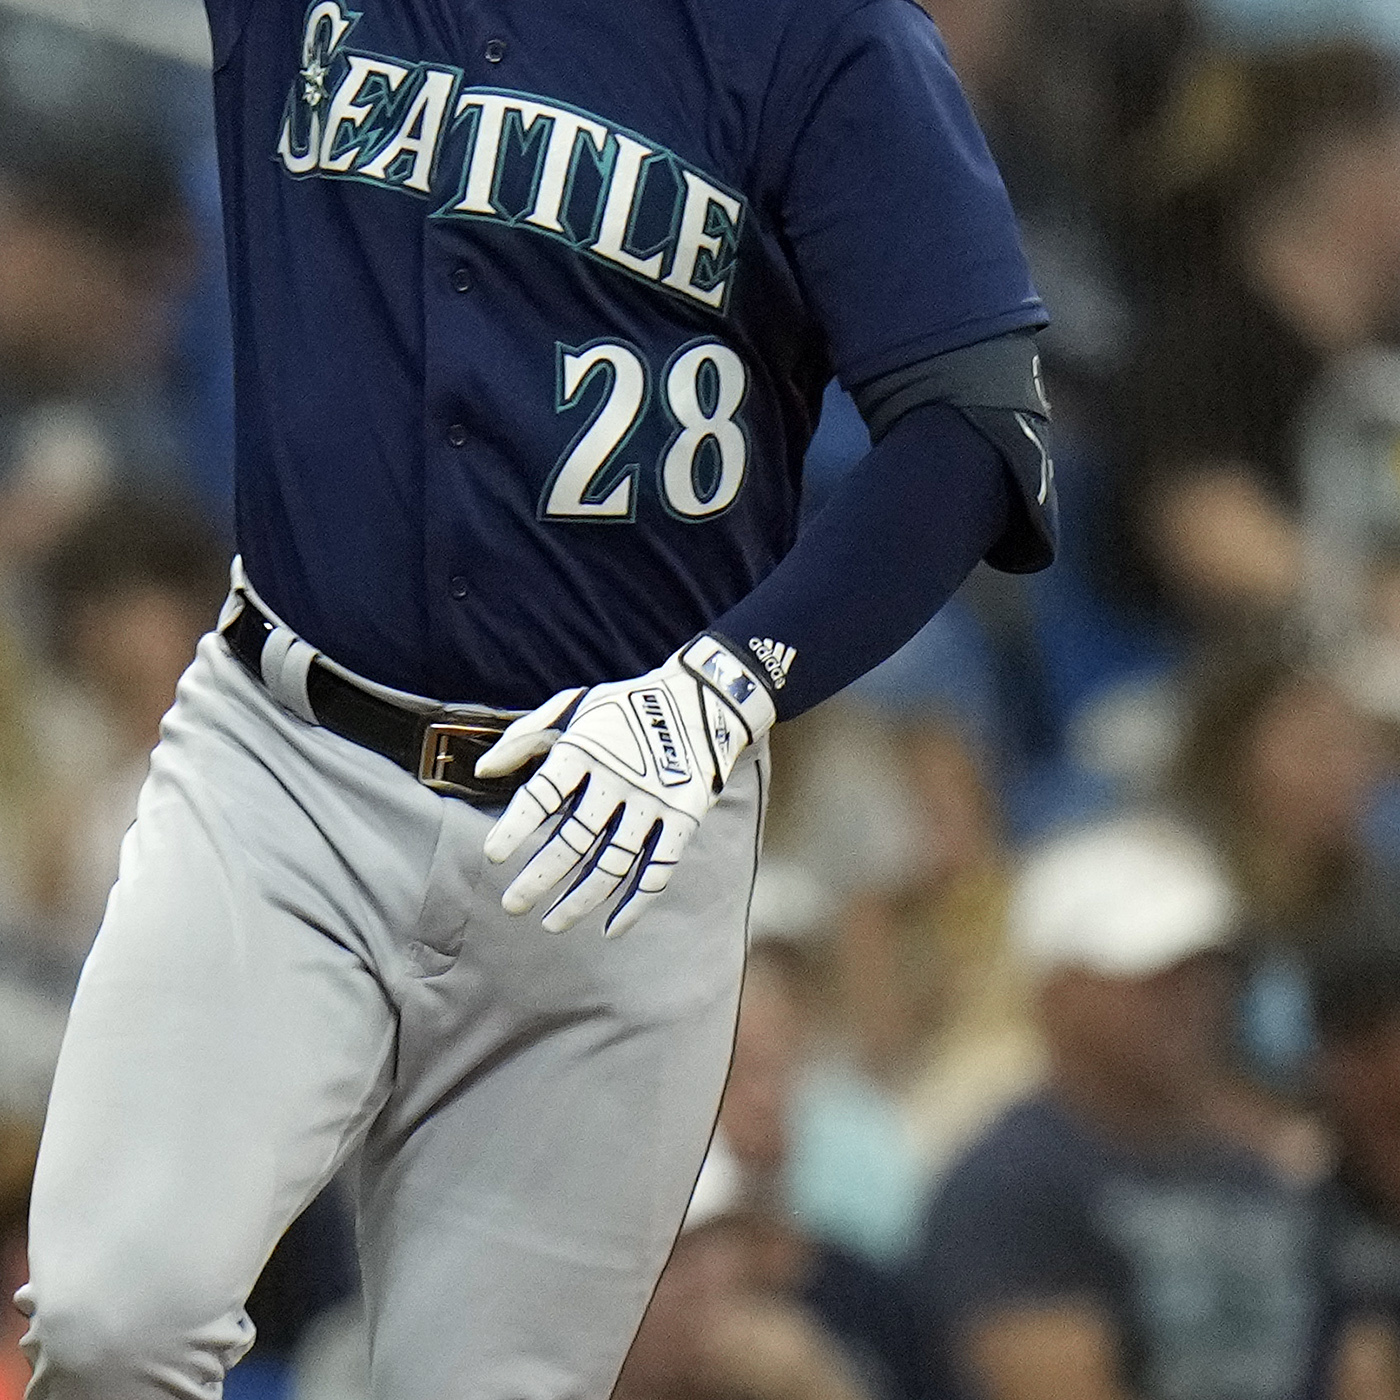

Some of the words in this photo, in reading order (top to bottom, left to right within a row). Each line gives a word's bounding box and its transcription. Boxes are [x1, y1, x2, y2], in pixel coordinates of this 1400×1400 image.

[537, 336, 753, 523] 28
[749, 637, 786, 690] adidas
[642, 693, 687, 776] Franklin
